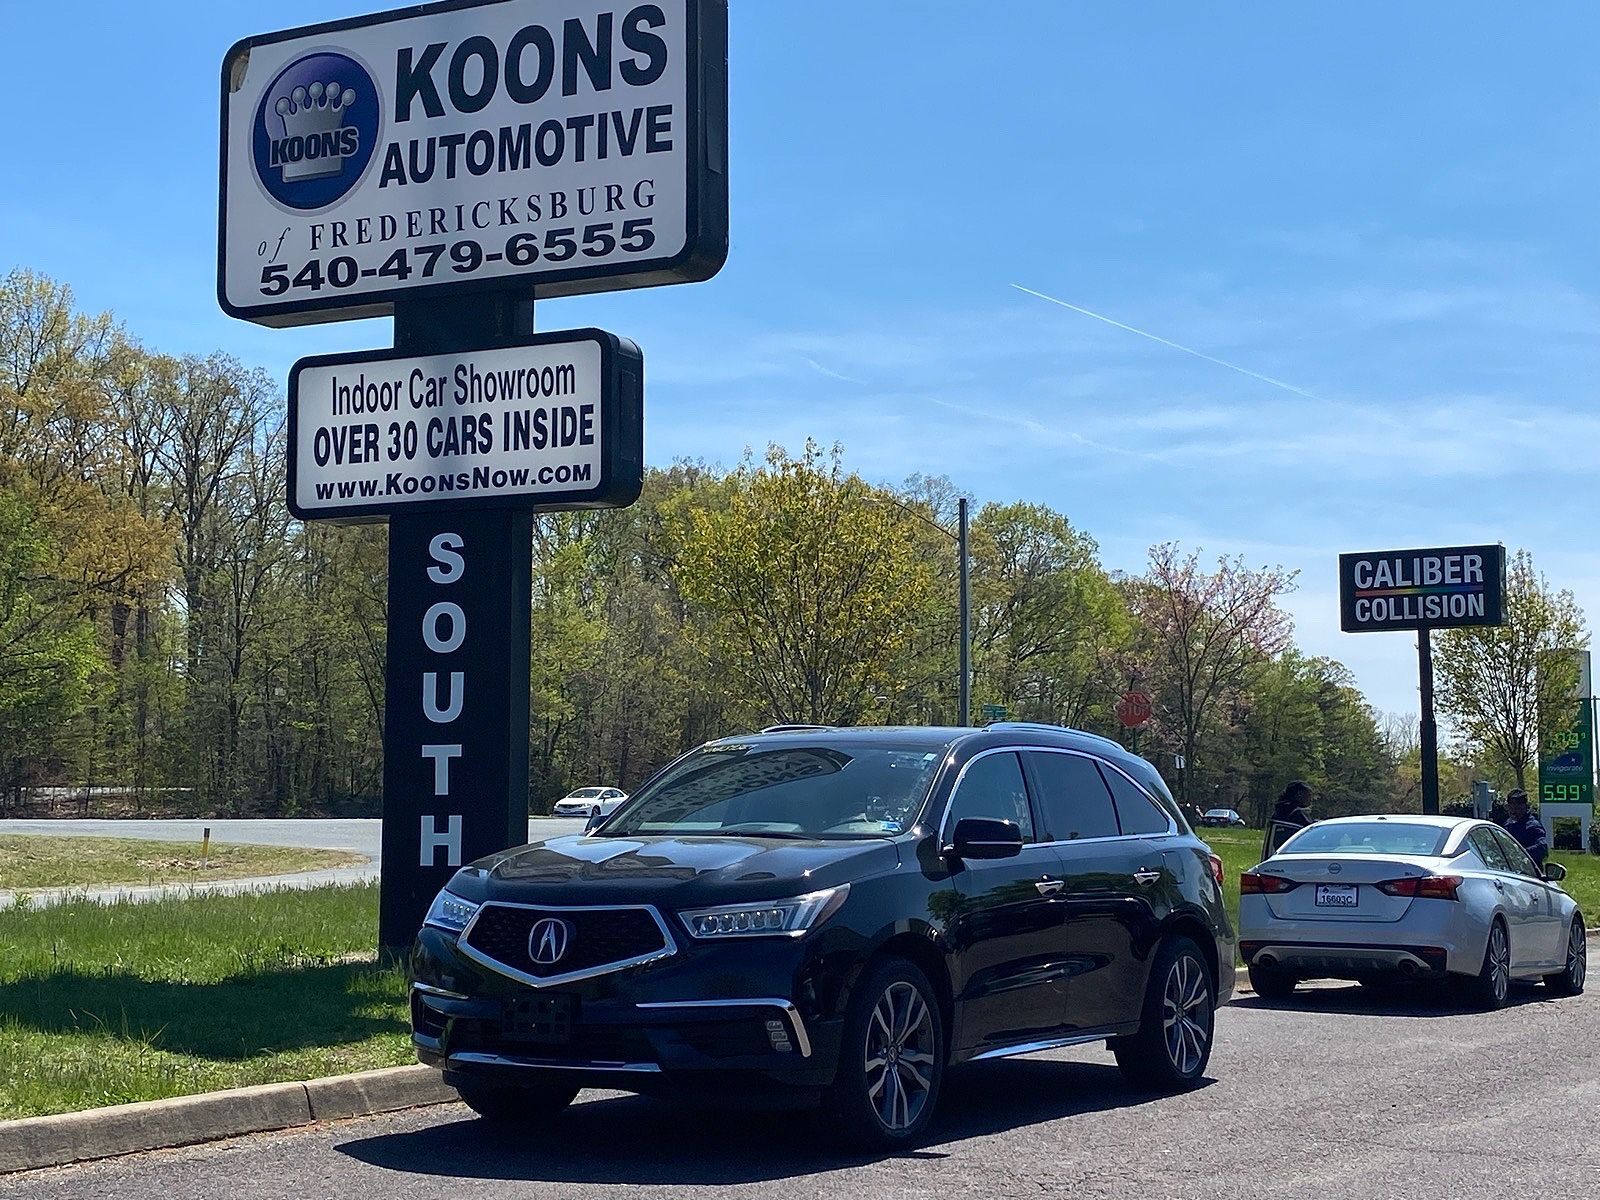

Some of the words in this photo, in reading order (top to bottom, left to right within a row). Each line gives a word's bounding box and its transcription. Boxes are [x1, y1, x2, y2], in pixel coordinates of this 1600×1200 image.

[394, 4, 668, 123] KOONS
[270, 126, 359, 168] KOONS
[379, 104, 674, 189] AUTOMOTIVE
[257, 226, 292, 264] of
[309, 178, 656, 251] FREDERICKSBURG
[259, 217, 656, 296] 540-479-6555
[332, 374, 403, 416] Indoor
[409, 368, 448, 410] Car
[453, 362, 576, 406] Showroom
[313, 423, 380, 468] OVER
[387, 420, 418, 462] 30
[426, 412, 494, 457] CARS
[502, 404, 594, 452] INSIDE
[1354, 554, 1484, 589] CALIBER
[1355, 593, 1485, 622] COLLISION
[419, 532, 467, 867] SOUTH
